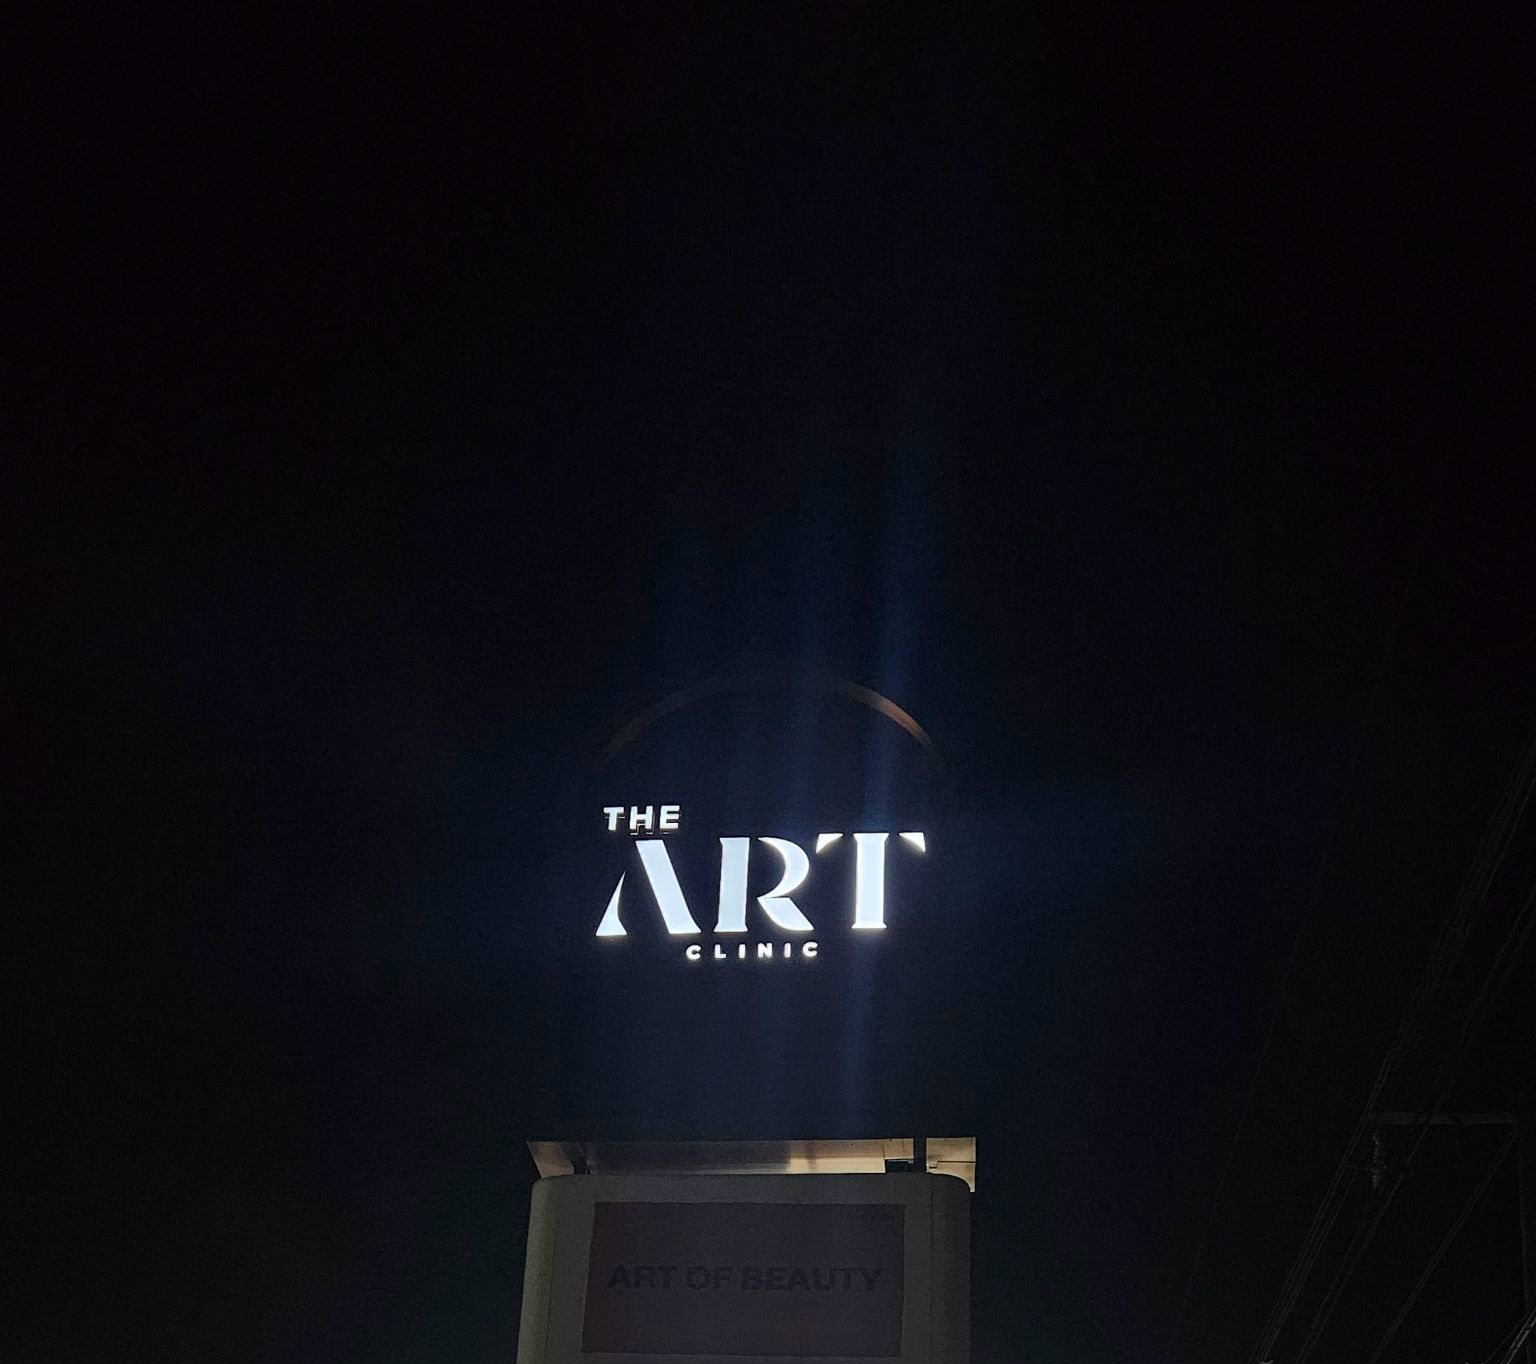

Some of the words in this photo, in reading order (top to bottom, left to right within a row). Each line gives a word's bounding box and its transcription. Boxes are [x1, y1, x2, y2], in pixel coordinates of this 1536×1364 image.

[603, 805, 680, 831] THE
[595, 832, 926, 936] ART
[685, 941, 819, 960] CLINIC
[607, 1264, 677, 1289] ART
[685, 1265, 733, 1290] OF
[740, 1266, 882, 1291] BEAUTY
